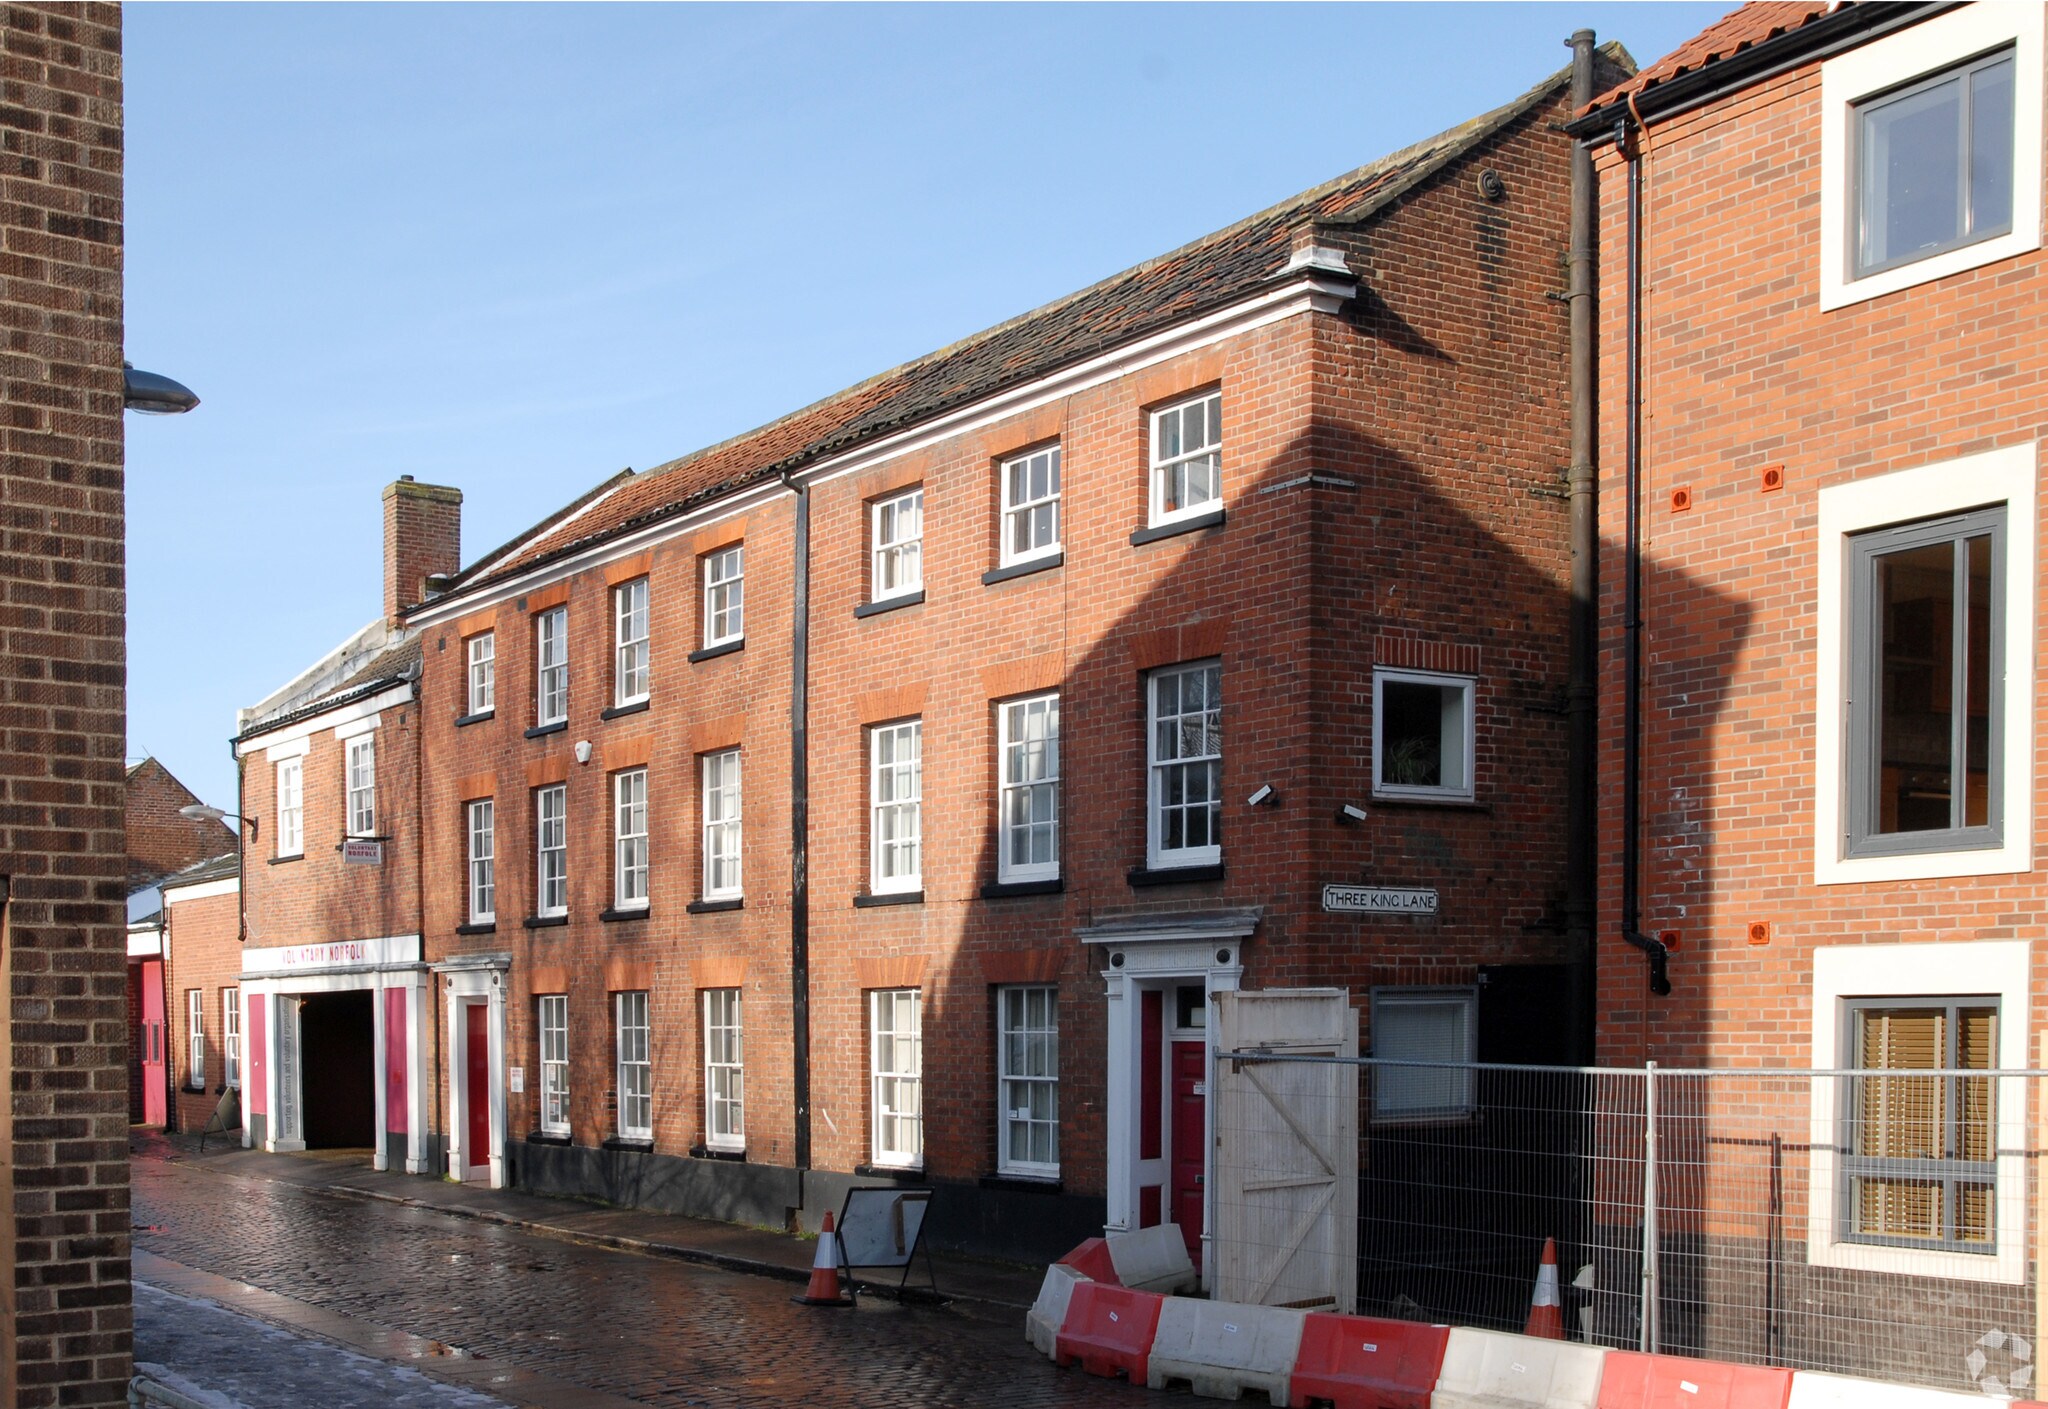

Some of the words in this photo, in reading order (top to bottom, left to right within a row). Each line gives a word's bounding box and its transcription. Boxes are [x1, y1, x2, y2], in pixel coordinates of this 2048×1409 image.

[1328, 892, 1367, 906] THREE
[1370, 894, 1399, 907] KING
[1403, 895, 1435, 908] LANE
[282, 947, 325, 964] VOLNTARY
[329, 944, 367, 961] NORFOLK
